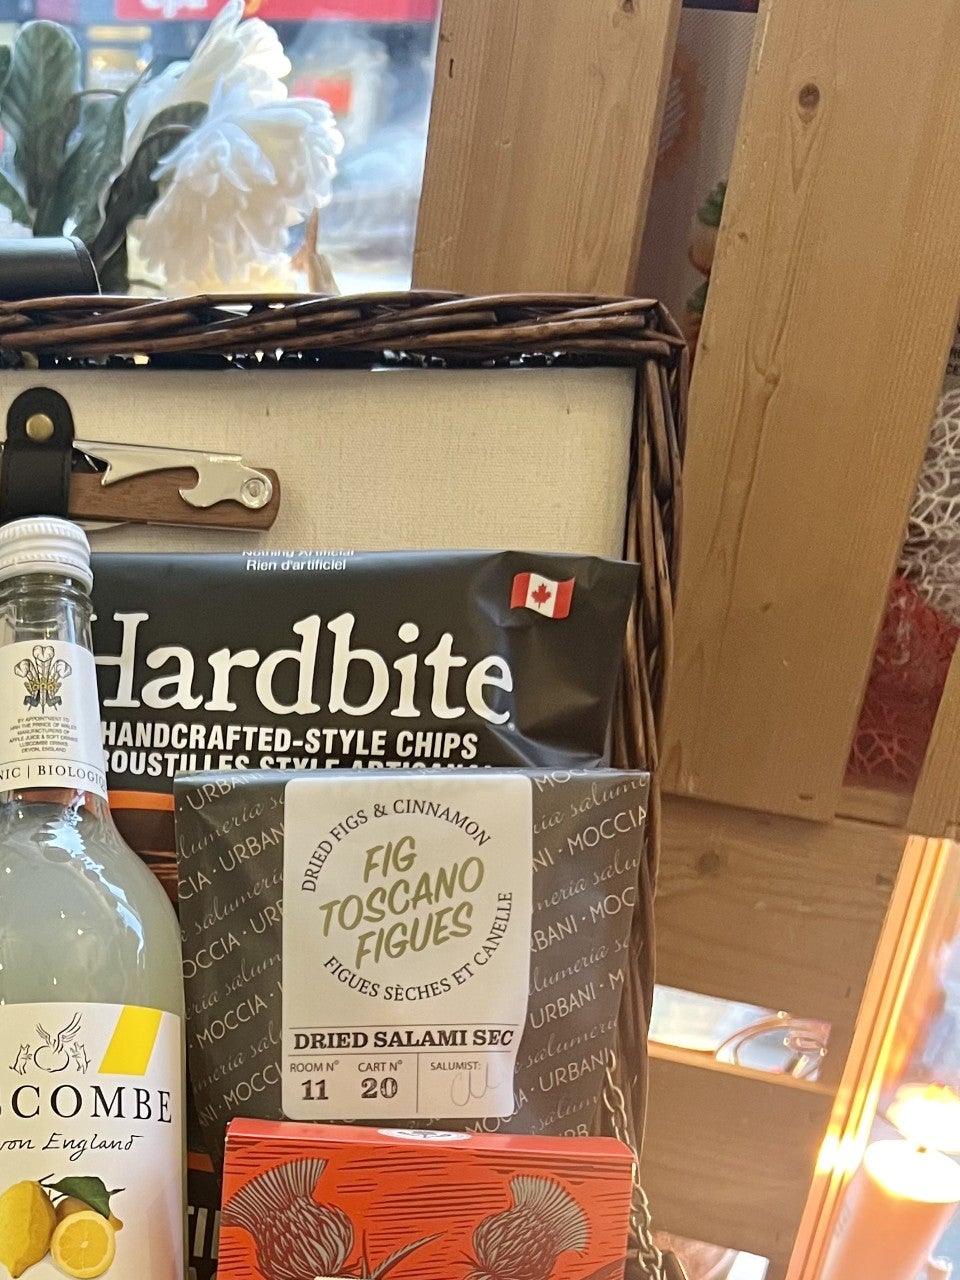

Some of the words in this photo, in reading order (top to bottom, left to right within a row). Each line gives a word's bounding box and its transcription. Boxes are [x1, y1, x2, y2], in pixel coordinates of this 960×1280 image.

[246, 559, 277, 571] Rien
[281, 559, 347, 571] d'artificiel
[90, 613, 514, 724] Hardbite
[101, 720, 387, 756] HANDCRAFTED-STYLE
[396, 731, 479, 760] CHIPS
[218, 822, 284, 872] URBAN
[301, 839, 333, 893] DRIED
[329, 809, 368, 842] FIGS
[373, 803, 389, 818] &
[393, 799, 491, 847] CINNAMON
[566, 804, 647, 856] MOCCIA
[363, 835, 417, 884] FIG
[318, 856, 484, 937] TOSCANO
[182, 932, 241, 979] OCCIA
[323, 955, 380, 998] FIGUES
[383, 978, 452, 1002] SÈCHES
[452, 962, 476, 986] ET
[473, 892, 513, 966] CANELLE
[354, 901, 474, 969] FIGUES
[195, 994, 268, 1050] MOCCIA
[529, 981, 597, 1030] URBANI
[293, 1032, 369, 1050] DRIED
[373, 1030, 468, 1048] SALAMI
[473, 1030, 514, 1047] SEC
[290, 1062, 324, 1073] ROOM
[358, 1062, 387, 1072] CART
[430, 1061, 481, 1071] SALUMIST:
[301, 1079, 329, 1100] 11
[361, 1077, 398, 1099] 20
[538, 1047, 610, 1092] URBANI
[41, 1131, 145, 1162] England
